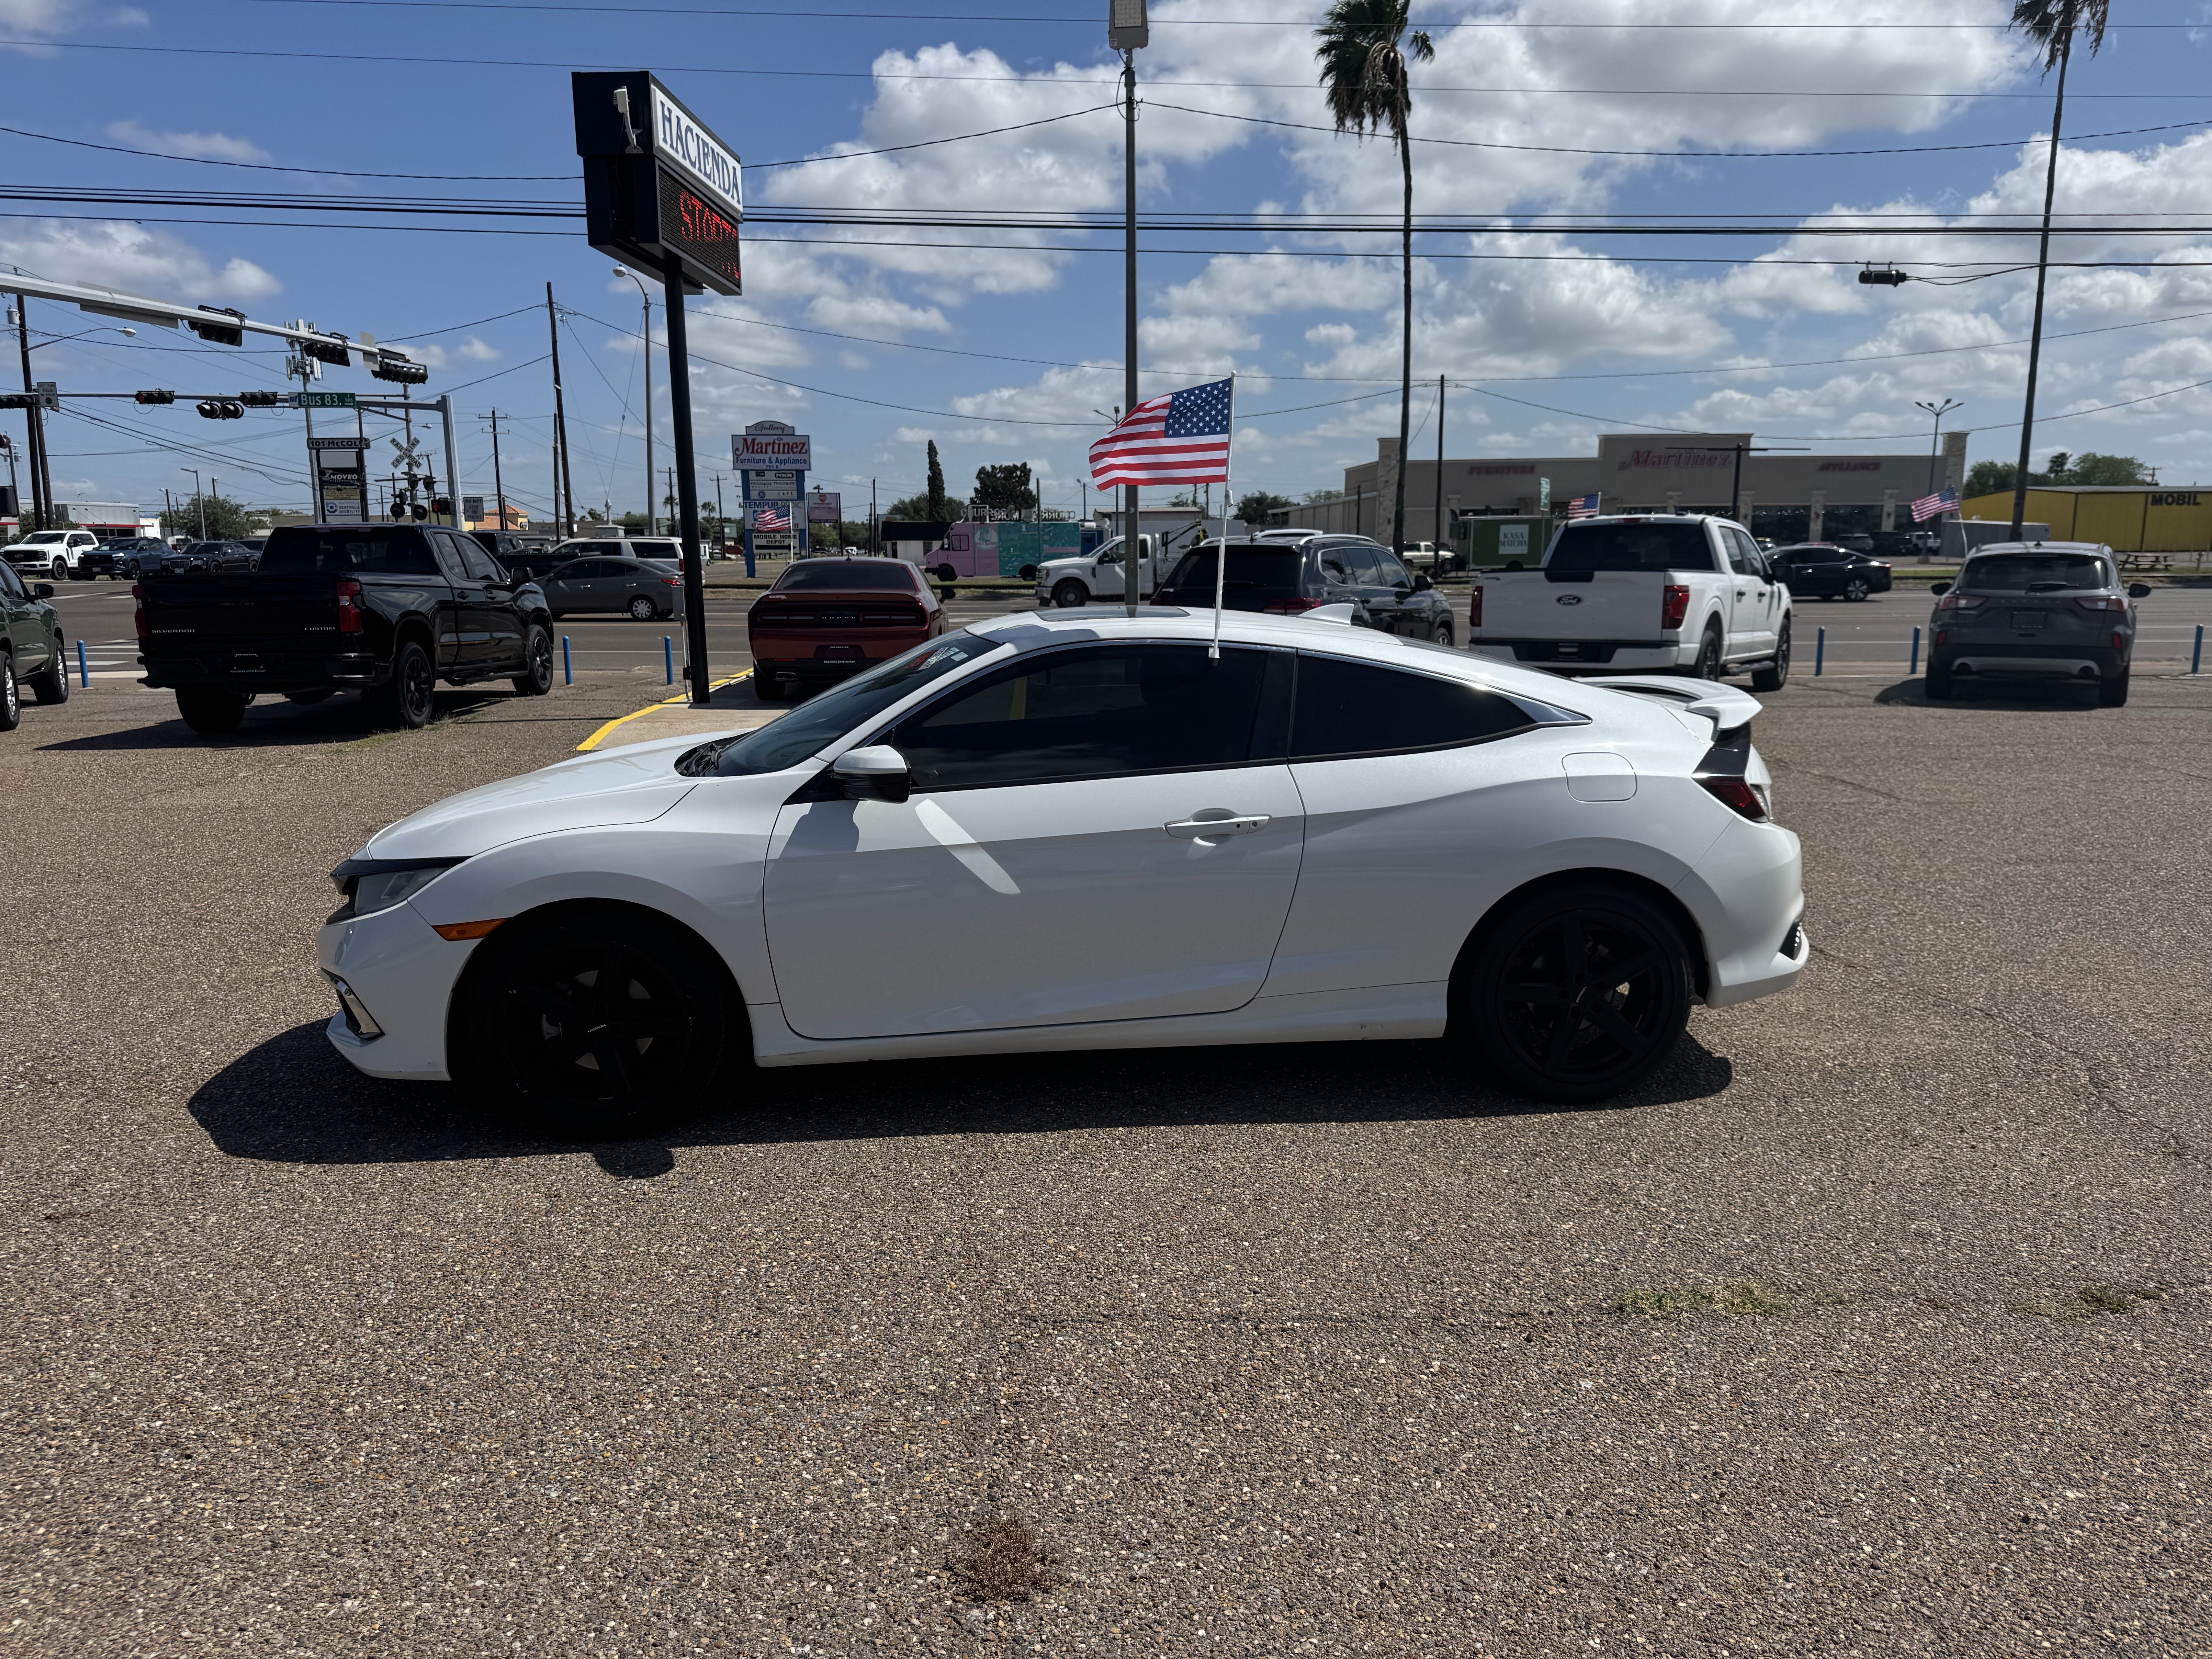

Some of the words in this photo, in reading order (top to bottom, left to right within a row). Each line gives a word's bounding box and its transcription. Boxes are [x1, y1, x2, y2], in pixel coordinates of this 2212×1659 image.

[660, 100, 740, 205] HACIENDA
[301, 394, 321, 405] Bus
[754, 424, 785, 433] Gallery
[734, 437, 808, 457] Martinez
[775, 457, 807, 466] Appliance
[1617, 450, 1732, 471] Martinez
[2151, 493, 2201, 506] MOBIL
